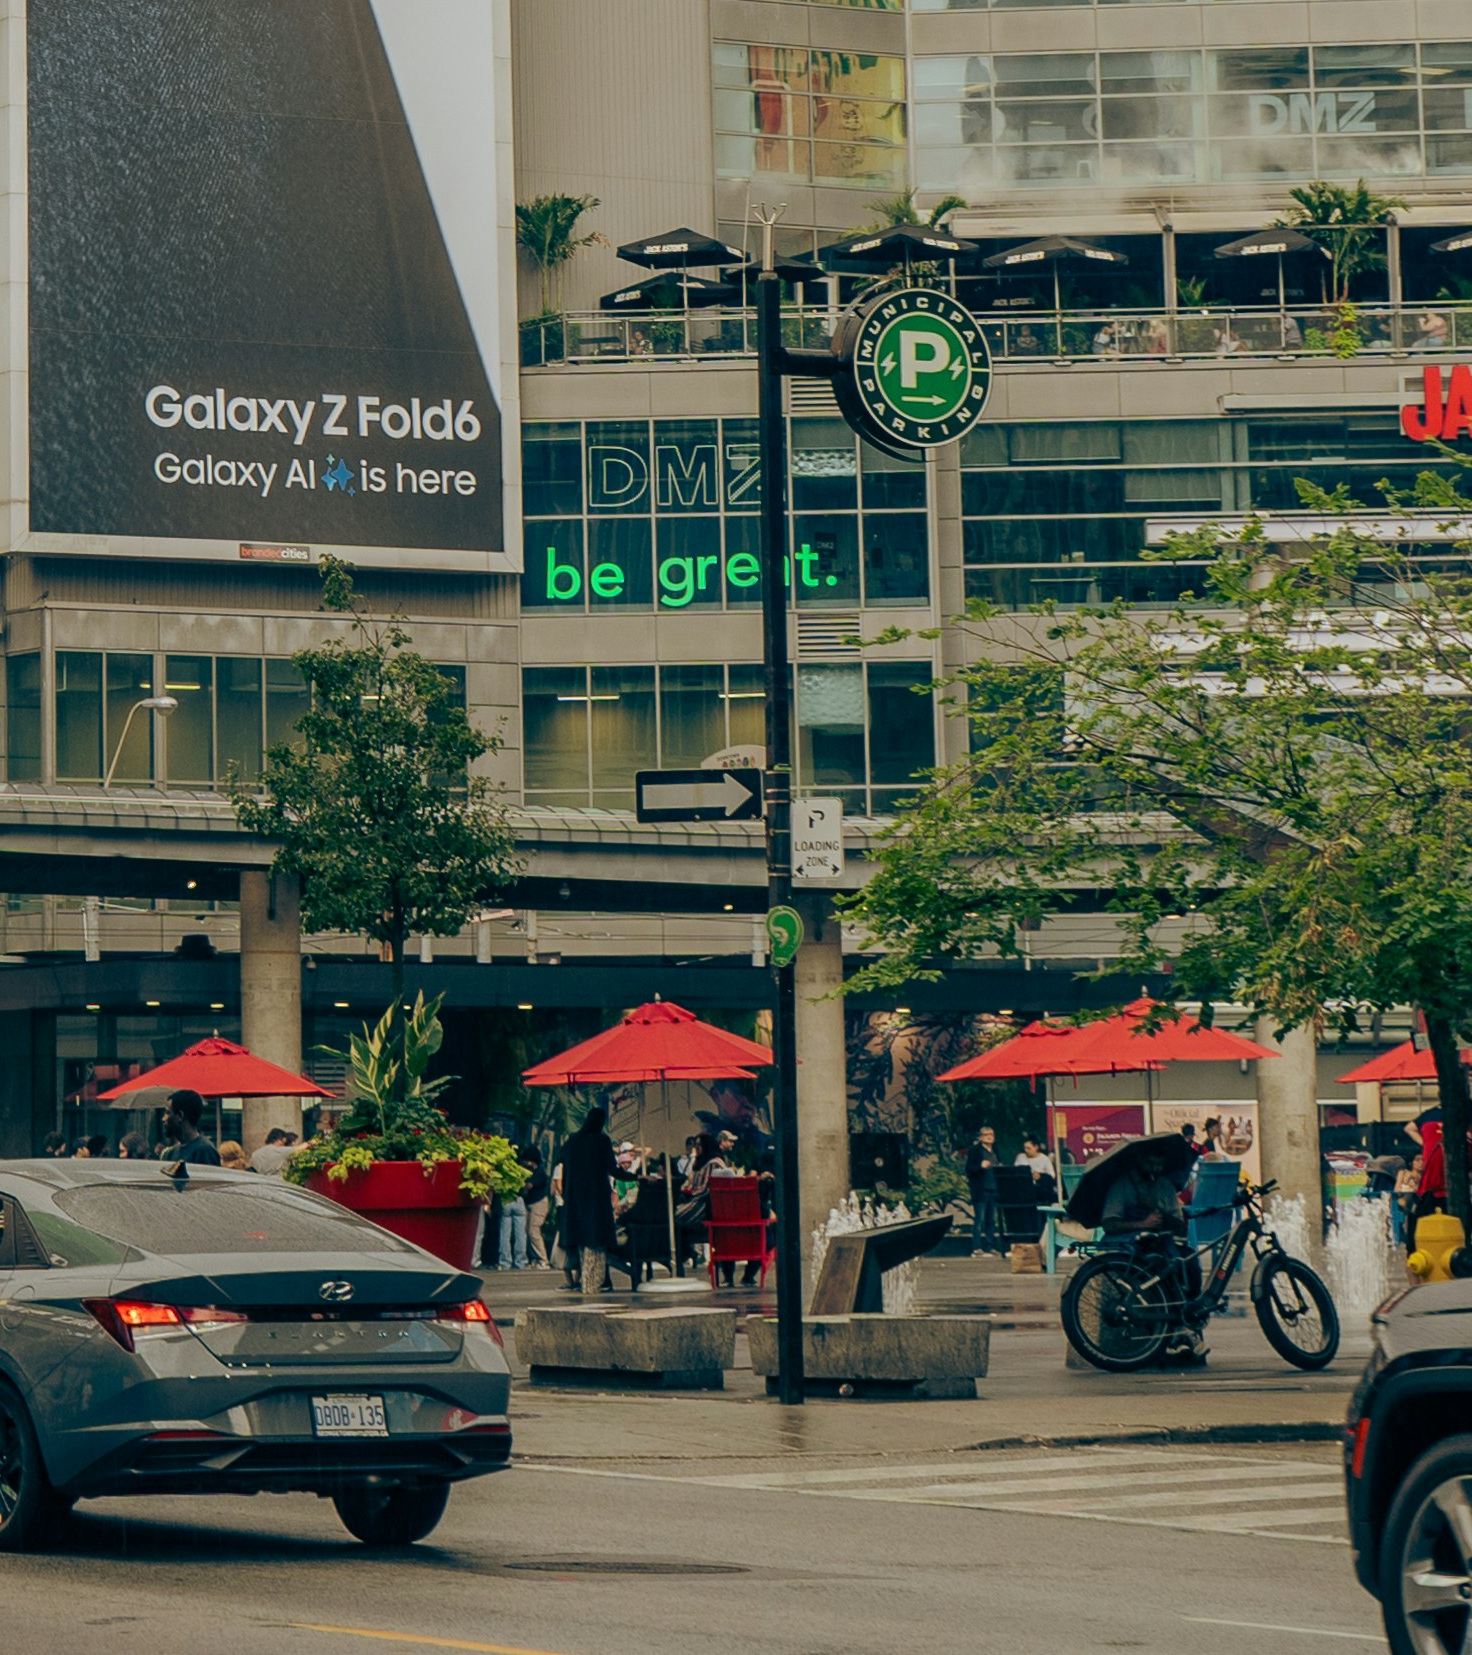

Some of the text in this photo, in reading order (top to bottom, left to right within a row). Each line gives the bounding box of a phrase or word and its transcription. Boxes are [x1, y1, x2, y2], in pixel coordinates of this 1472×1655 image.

[1249, 91, 1377, 135] DMZ
[860, 296, 984, 365] MUNICIPAL
[898, 330, 951, 390] P
[145, 384, 481, 446] Galaxy Z Fold6
[860, 376, 984, 439] PARKING
[154, 451, 478, 498] Galaxy AI is here
[546, 543, 838, 608] be gret.
[794, 841, 840, 852] LOADING
[806, 857, 829, 867] ZONE
[359, 1404, 384, 1427] 135
